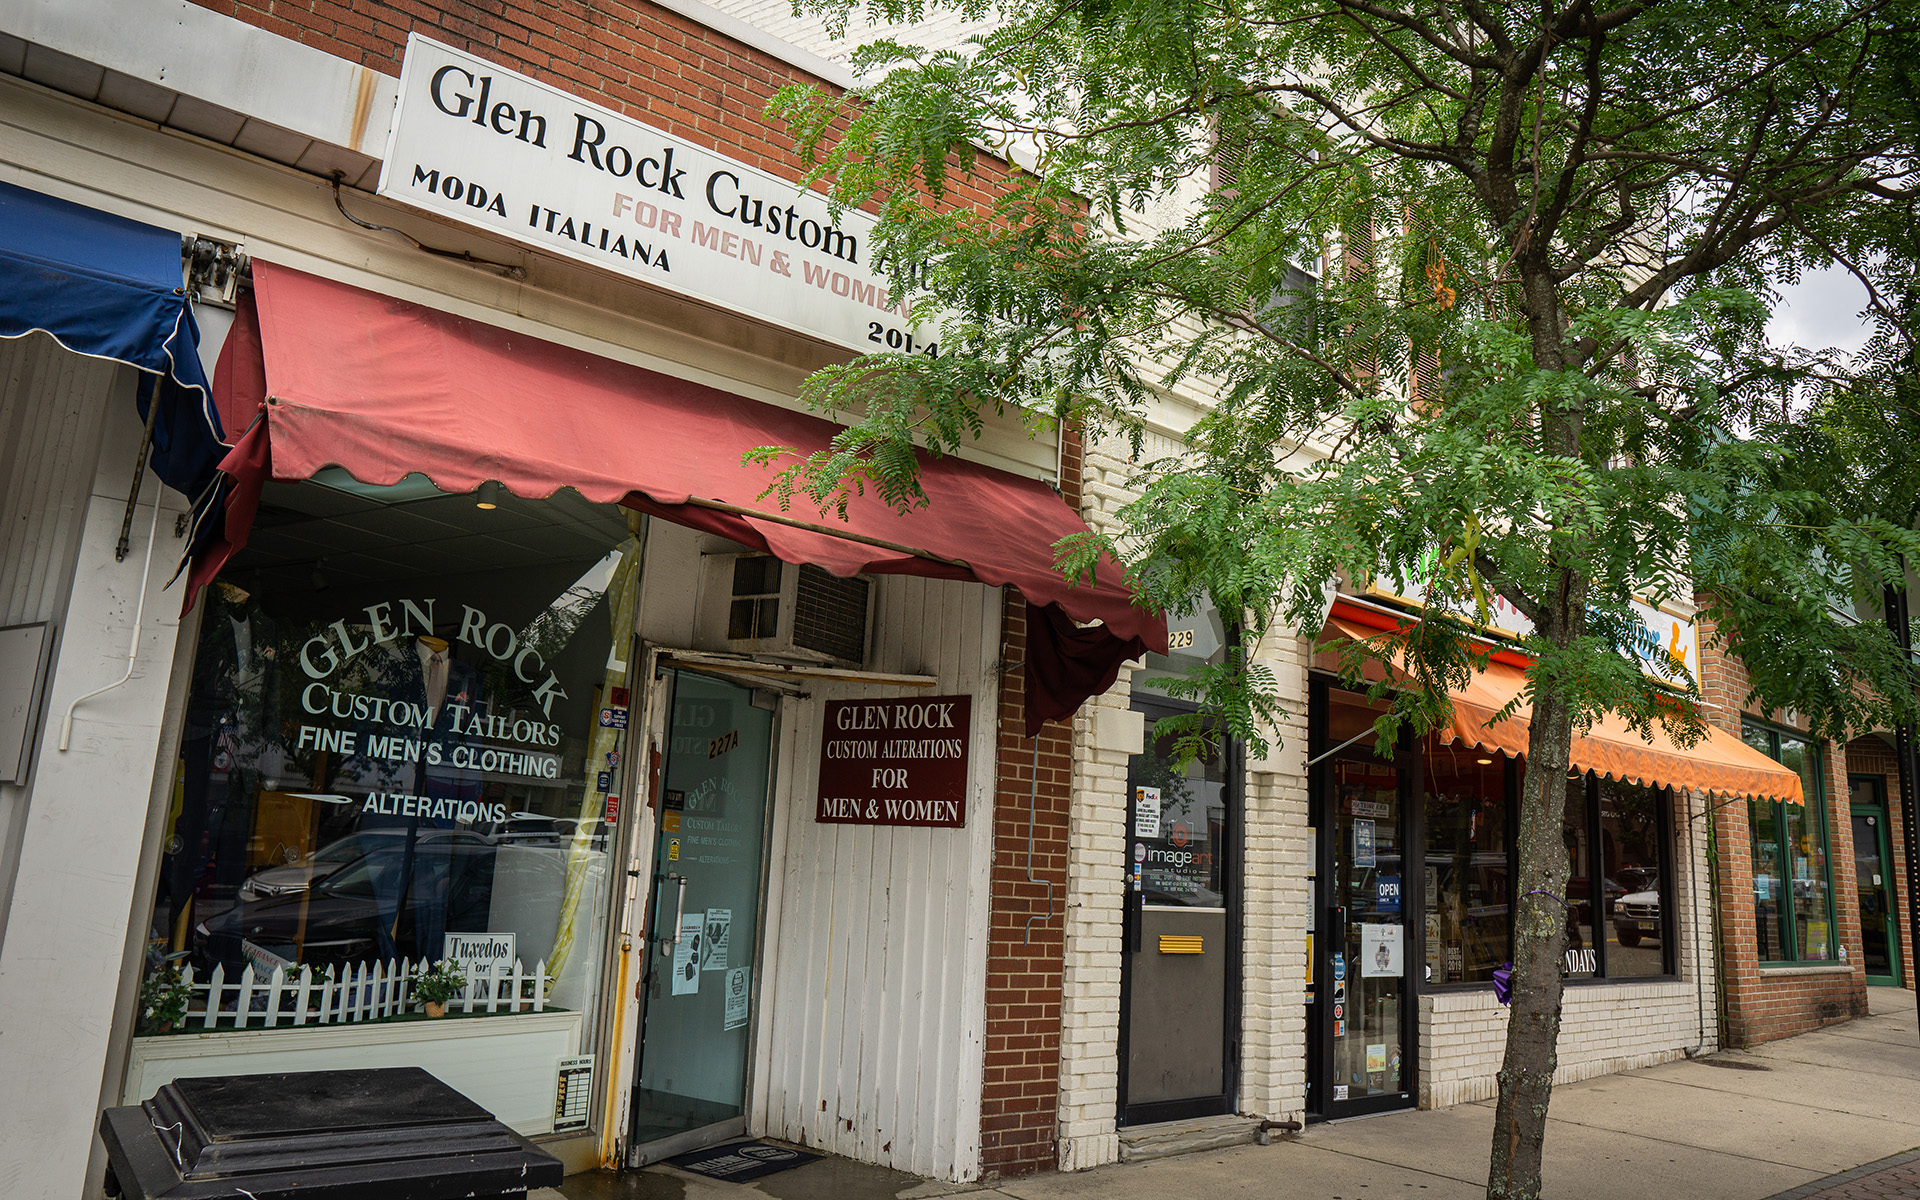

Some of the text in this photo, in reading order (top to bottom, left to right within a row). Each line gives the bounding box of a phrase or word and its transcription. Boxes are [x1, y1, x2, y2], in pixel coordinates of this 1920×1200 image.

[429, 65, 860, 265] Glen Rock Custom
[410, 163, 671, 273] MODA ITALIANA
[612, 191, 682, 239] FOR
[692, 220, 762, 267] MEN
[769, 249, 793, 278] &
[803, 261, 913, 320] WOMEN
[867, 321, 940, 361] 201-4
[1169, 631, 1193, 648] 229
[299, 598, 569, 721] GLEN ROCK
[301, 682, 561, 747] CUSTOM TAILORS
[836, 703, 956, 731] GLEN ROCK
[298, 725, 357, 755] FINE
[367, 734, 443, 766] MEN'S
[452, 745, 558, 779] CLOTHING
[709, 729, 738, 760] 227A
[826, 738, 963, 759] CUSTOM ALTERATIONS
[871, 768, 909, 789] FOR
[688, 777, 717, 809] GLEN
[362, 792, 507, 824] ALTERATIONS
[822, 798, 959, 822] MEN & WOMEN
[687, 817, 714, 831] CUSTOM
[687, 835, 699, 845] FINE
[1379, 883, 1399, 897] OPEN
[243, 943, 279, 966] LEARANCE
[450, 937, 509, 958] Tuxedos
[474, 961, 490, 973] or
[1448, 960, 1462, 971] 2019
[1565, 949, 1597, 972] NDAYS
[561, 1059, 578, 1067] BUSINESS
